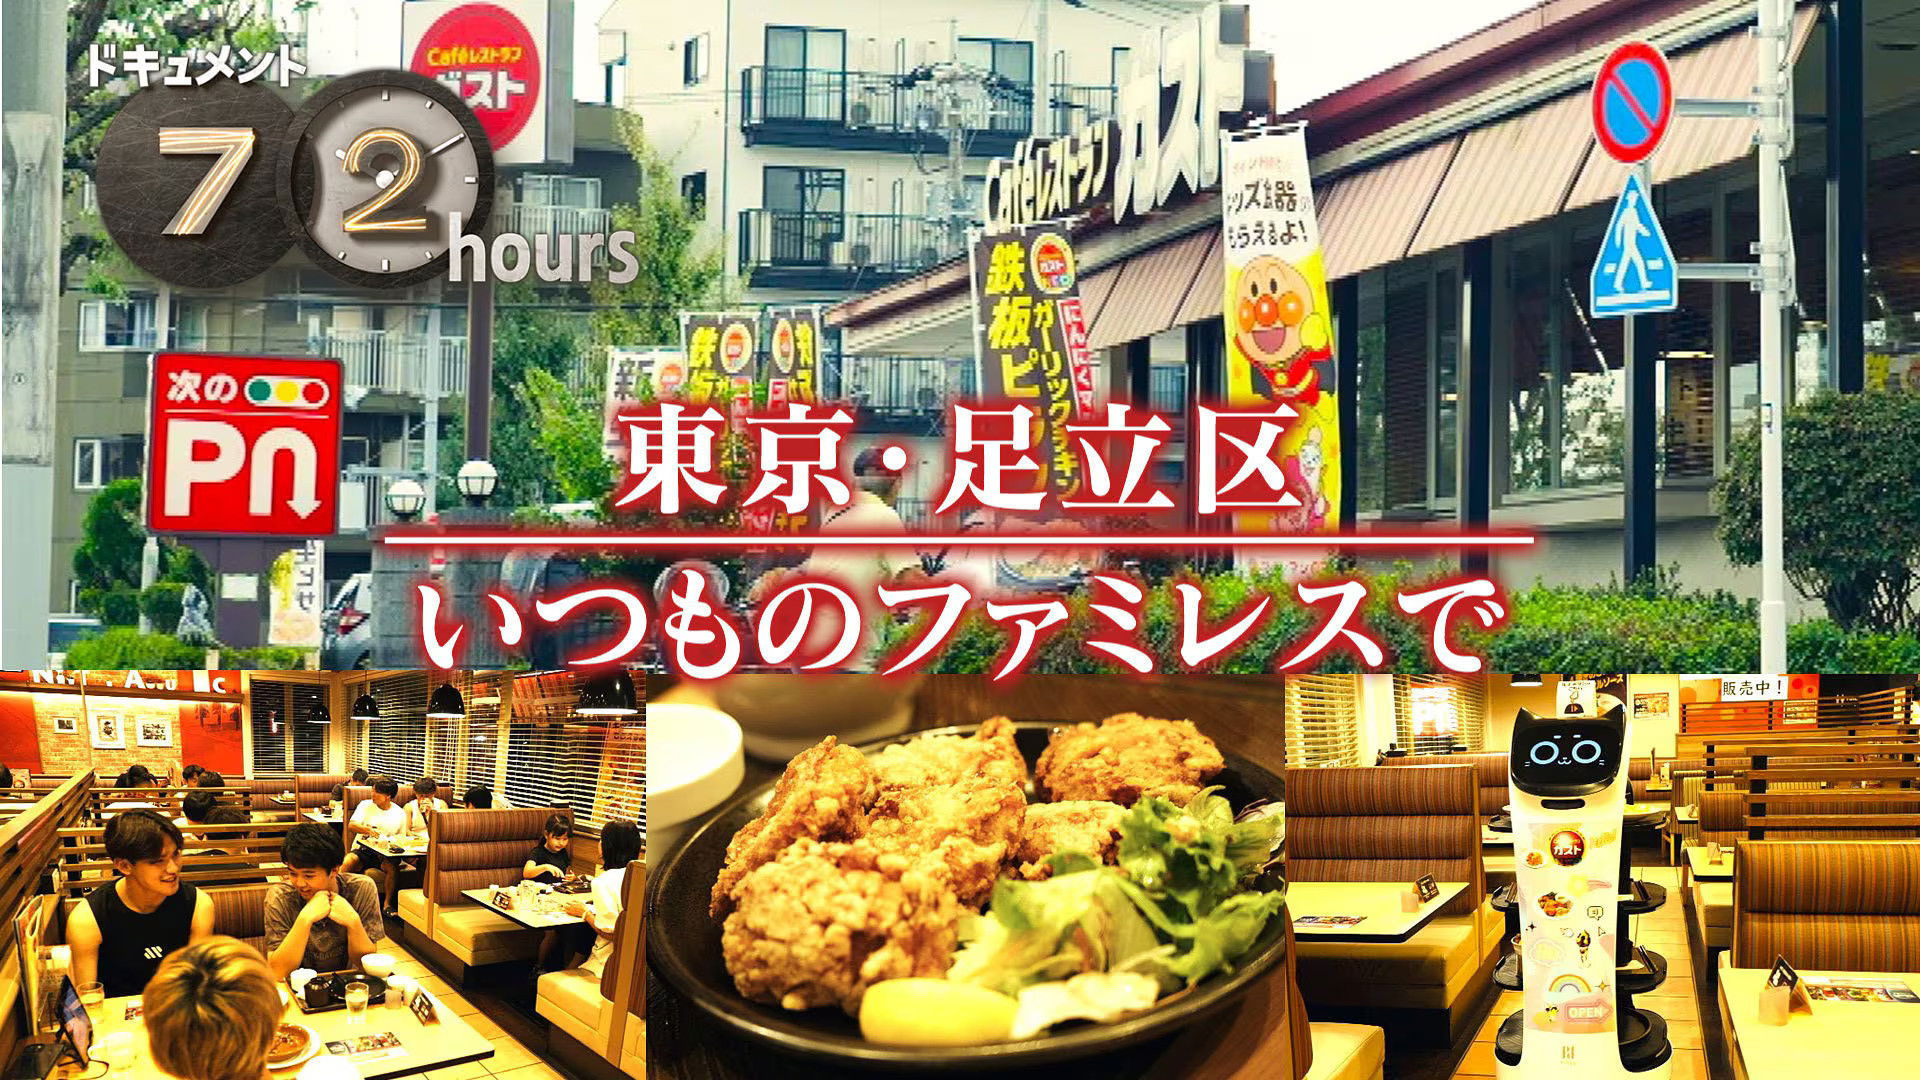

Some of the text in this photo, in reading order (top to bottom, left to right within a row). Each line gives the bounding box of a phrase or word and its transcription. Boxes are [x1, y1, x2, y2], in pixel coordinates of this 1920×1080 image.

[1114, 5, 1244, 224] ガスト
[167, 369, 239, 404] 次の
[1722, 680, 1782, 697] 販売中！
[1553, 845, 1582, 856] ガスト
[1568, 1007, 1603, 1019] OPEN
